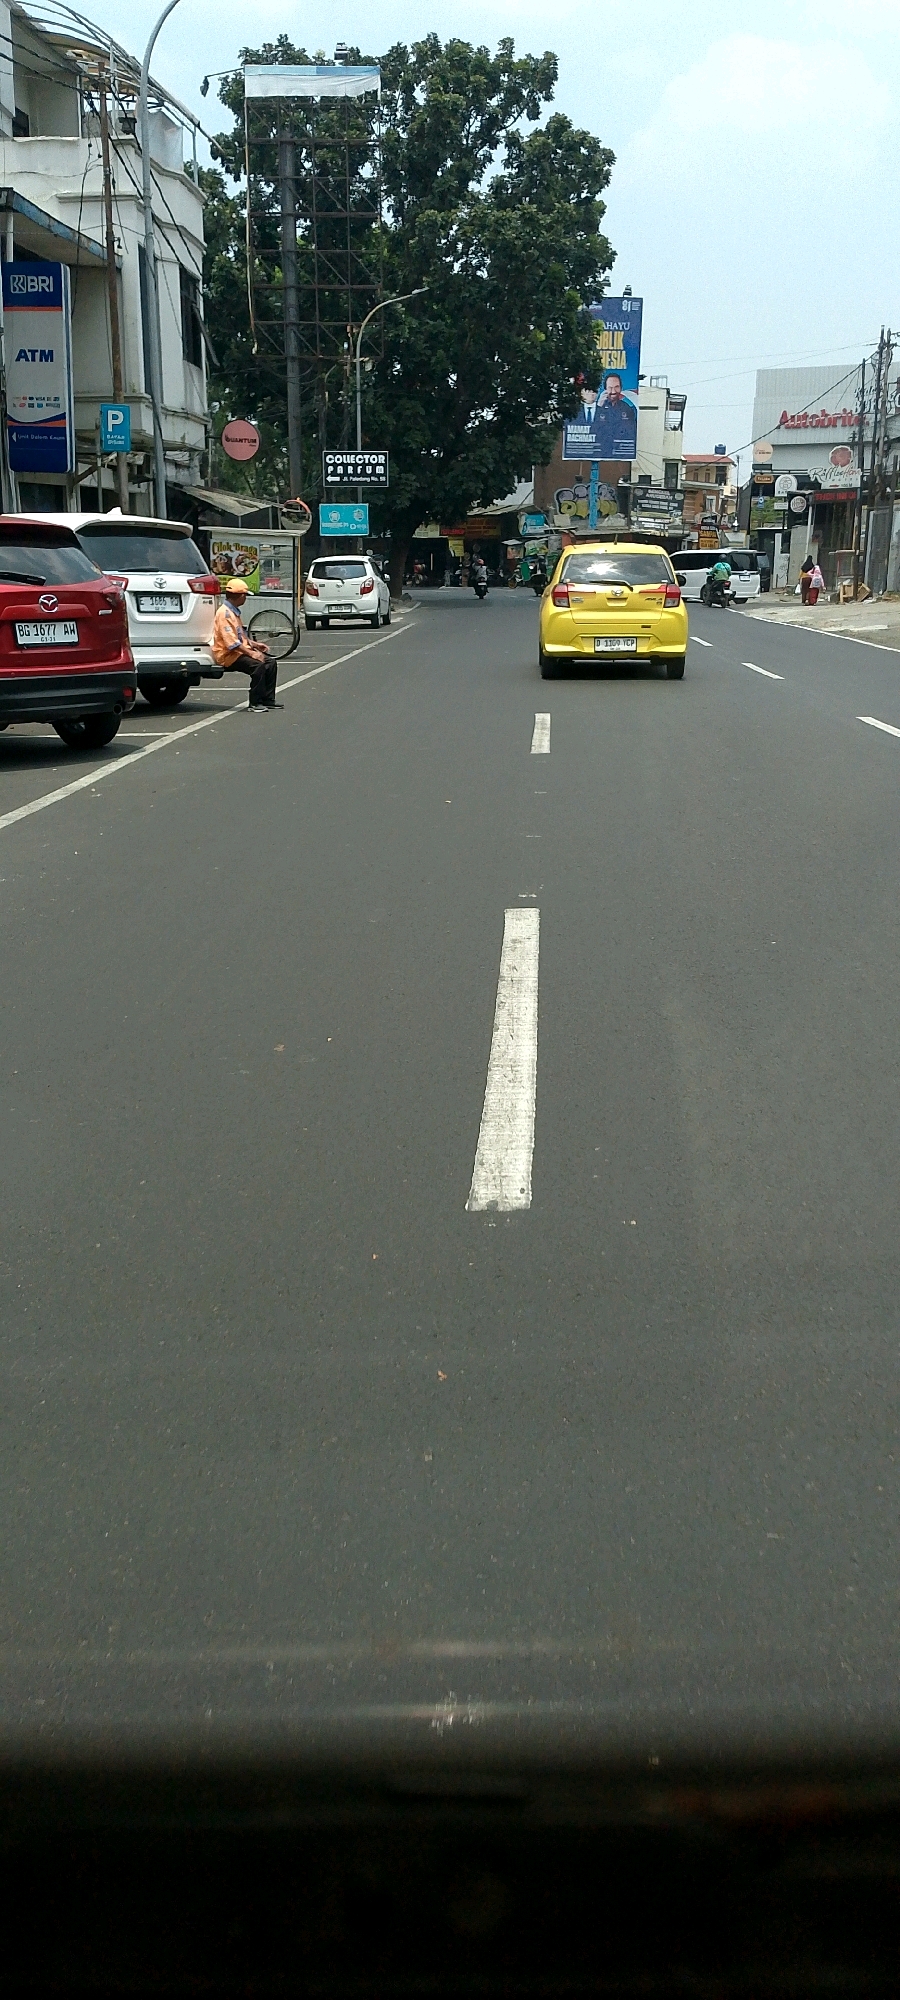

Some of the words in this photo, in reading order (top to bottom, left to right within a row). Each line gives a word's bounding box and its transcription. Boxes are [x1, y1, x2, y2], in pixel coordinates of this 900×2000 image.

[27, 275, 54, 292] BRI
[603, 321, 631, 331] AHAYU
[15, 348, 54, 362] ATM
[107, 409, 124, 432] P
[567, 424, 591, 434] MAMAT
[325, 454, 386, 464] COLLECTOR
[327, 465, 385, 474] PARFUM
[17, 624, 31, 637] BG
[33, 623, 56, 636] 1677
[63, 623, 76, 636] AW
